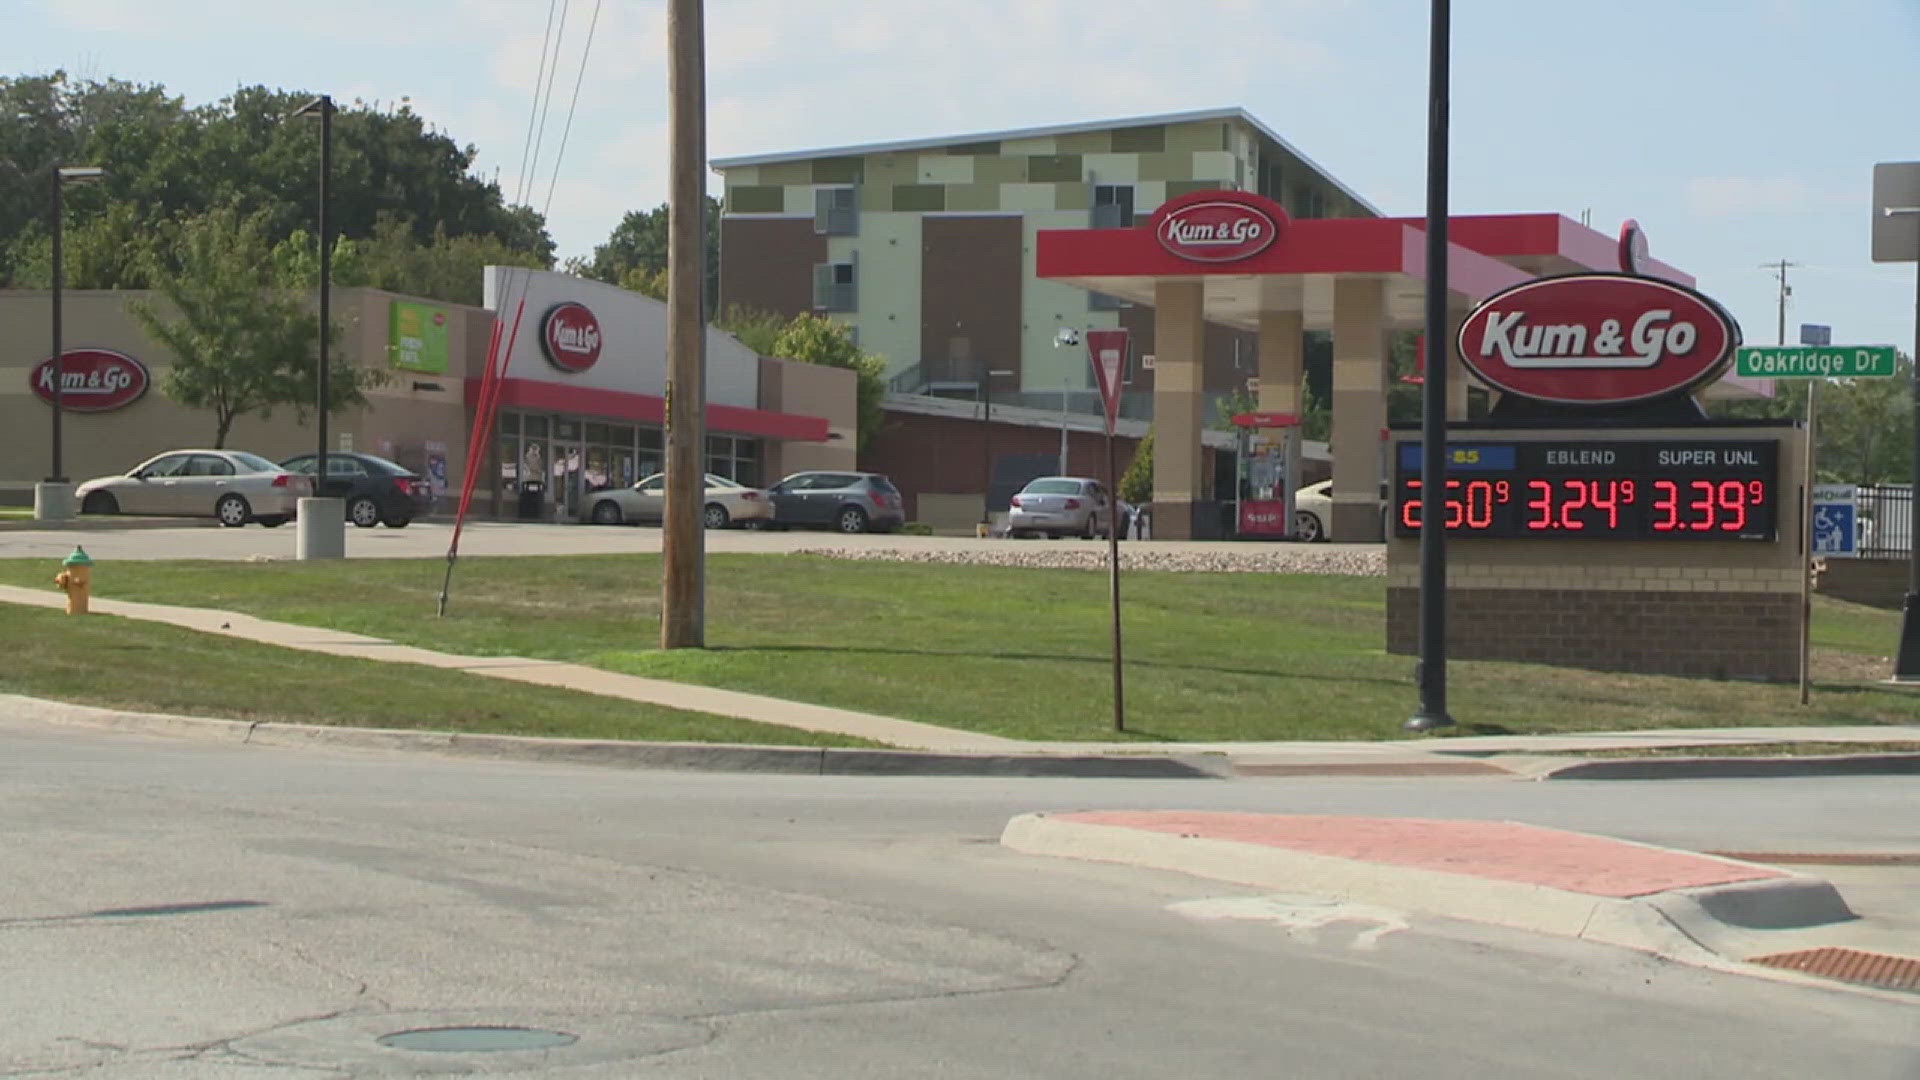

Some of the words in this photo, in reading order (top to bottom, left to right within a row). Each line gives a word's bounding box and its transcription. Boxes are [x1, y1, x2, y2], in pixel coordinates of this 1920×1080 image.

[1168, 219, 1213, 244] Kum
[1217, 223, 1229, 238] &
[1234, 218, 1260, 243] Go
[1480, 311, 1587, 366] Kum
[1594, 319, 1625, 355] &
[1631, 309, 1696, 362] Go
[1750, 351, 1844, 375] Oakridge
[1855, 350, 1880, 371] Dr
[40, 366, 85, 392] Km
[88, 371, 100, 387] &
[104, 367, 131, 391] Go
[1546, 451, 1616, 465] EBLEND
[1658, 451, 1716, 465] SUPER
[1724, 451, 1759, 465] UNL
